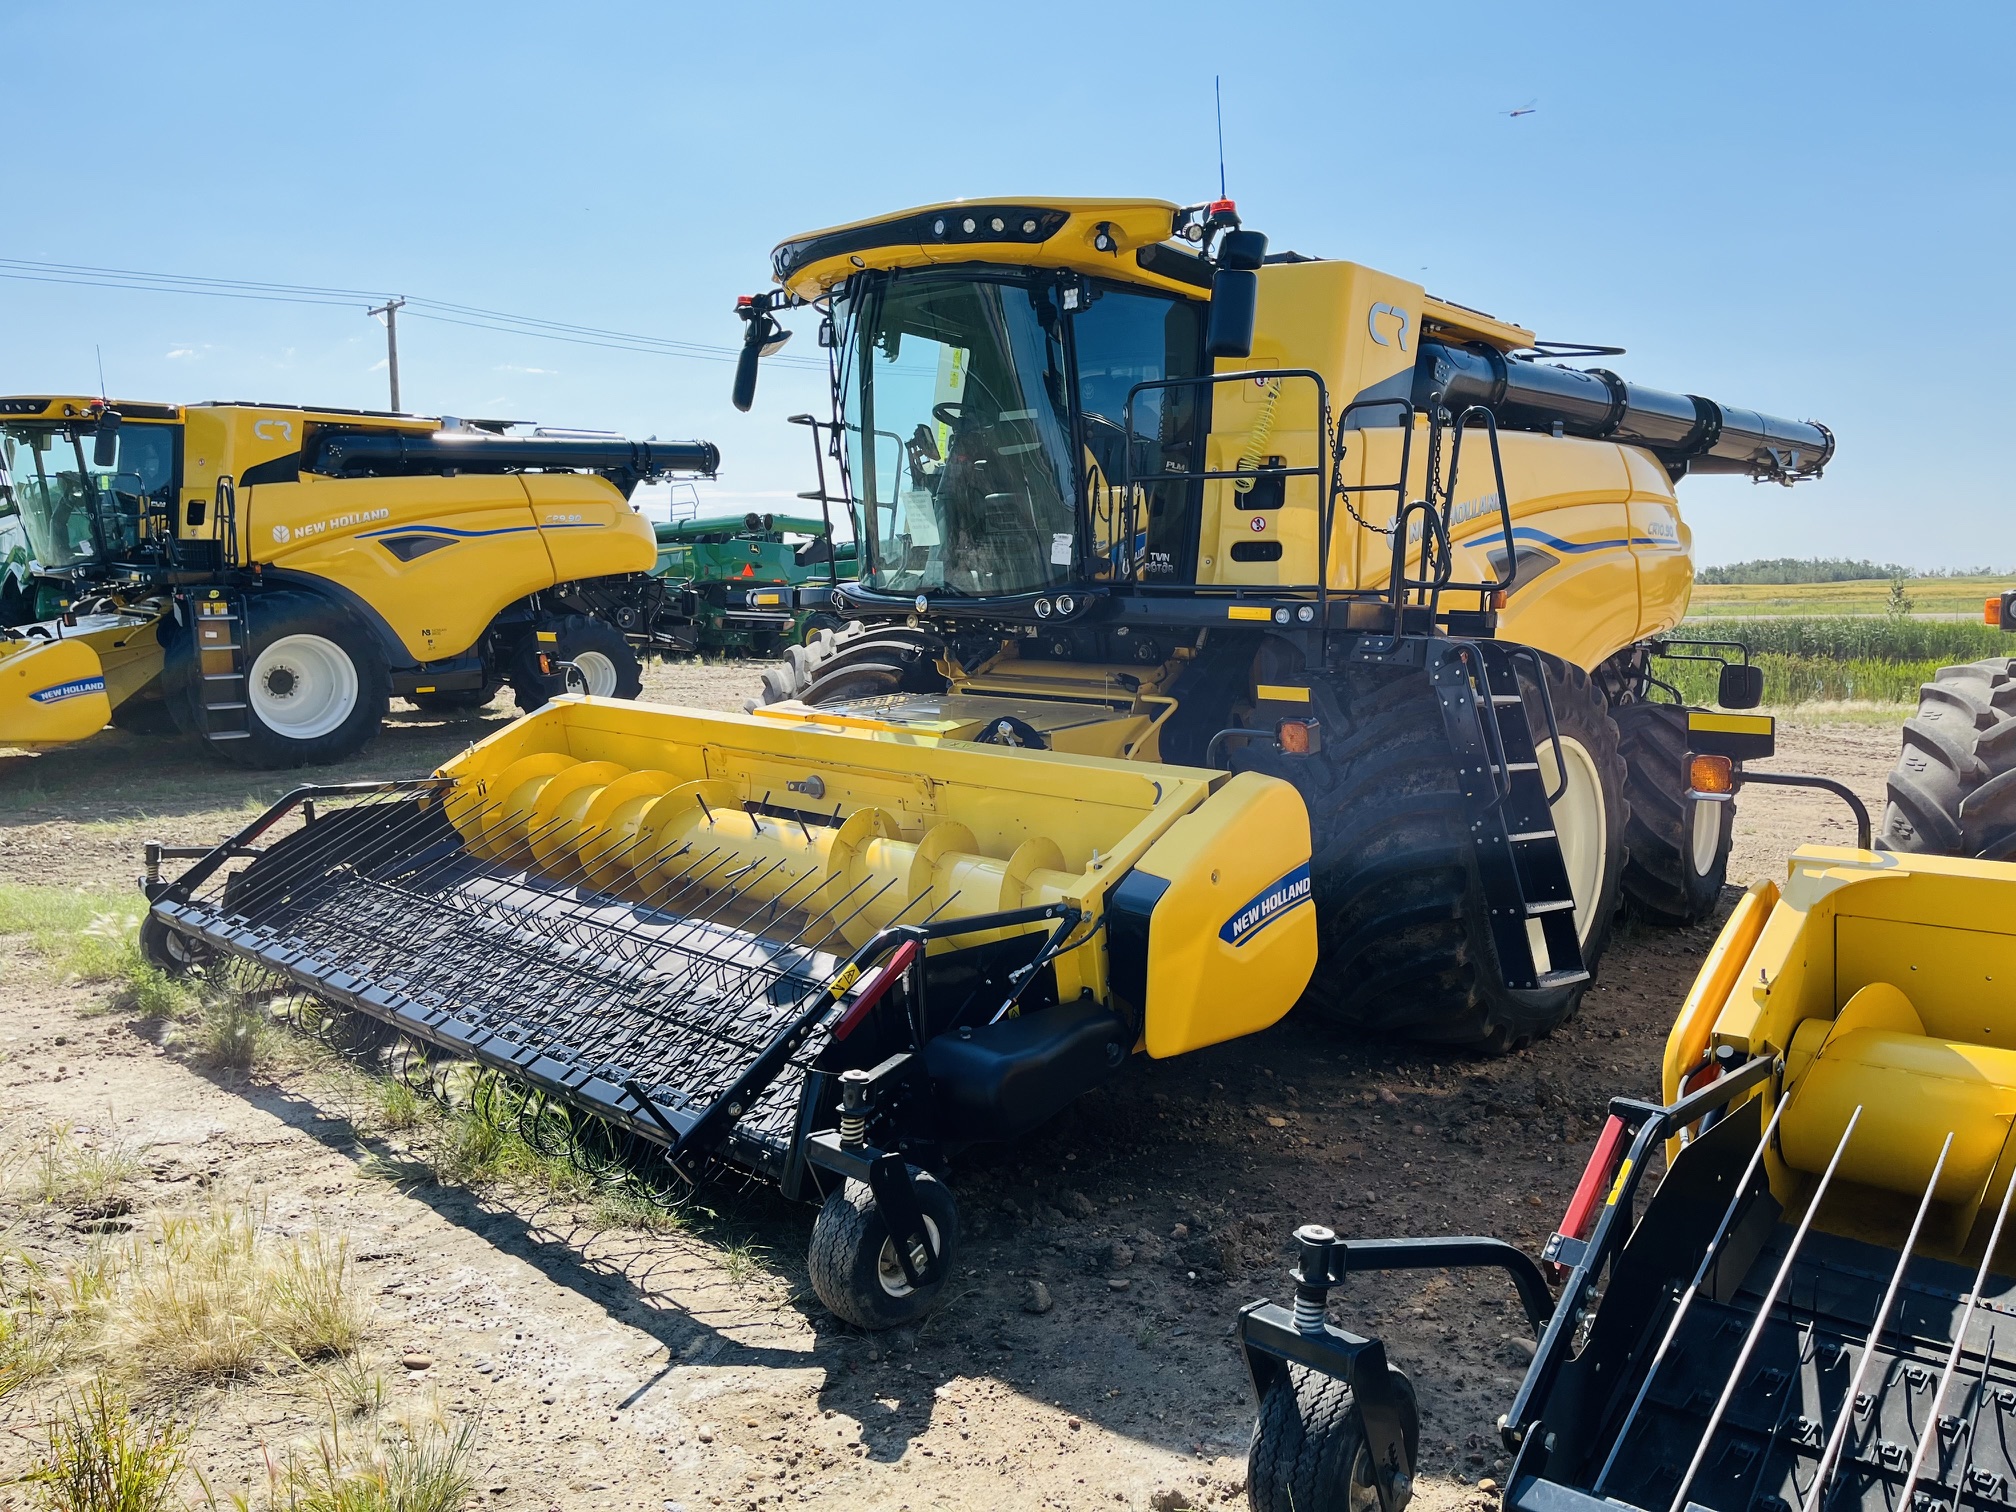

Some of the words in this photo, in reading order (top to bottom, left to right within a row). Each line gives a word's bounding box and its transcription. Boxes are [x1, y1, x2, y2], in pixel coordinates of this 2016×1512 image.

[1367, 301, 1410, 352] CR
[254, 419, 292, 441] CR
[1165, 460, 1185, 471] PLM
[294, 521, 326, 539] NEW
[330, 508, 390, 529] HOLLAND
[1145, 560, 1174, 573] ROTOR
[1150, 552, 1170, 562] TWIN
[41, 688, 62, 700] NEW
[63, 682, 104, 695] HOLLAND
[1232, 904, 1260, 937] NEW
[1261, 877, 1310, 916] HOLLAND
